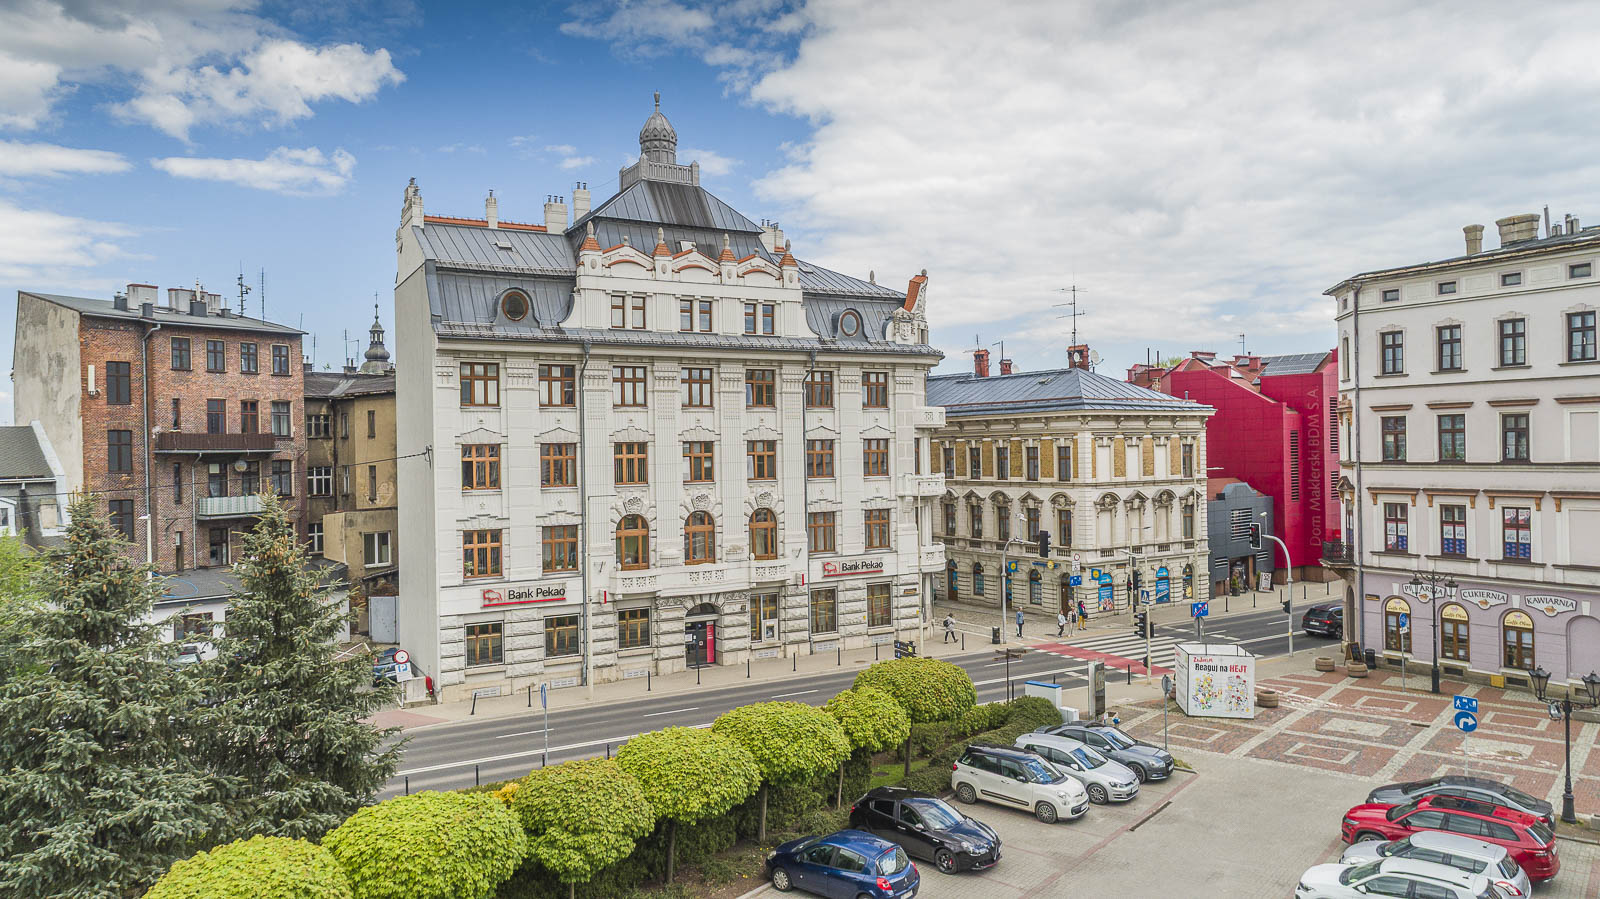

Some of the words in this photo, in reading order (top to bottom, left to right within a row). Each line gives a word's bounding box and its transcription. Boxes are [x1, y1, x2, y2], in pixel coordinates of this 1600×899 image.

[1307, 413, 1320, 447] BDM
[1308, 449, 1321, 511] Maklerski
[1309, 515, 1321, 547] Dom
[842, 562, 860, 572] Bank
[861, 560, 884, 570] Pekao
[508, 588, 534, 600] Bank
[536, 586, 566, 598] Pekao
[1404, 585, 1443, 596] PIARIA
[1462, 590, 1506, 602] CUKIERNIA
[1526, 596, 1575, 609] KAWIARNIA
[1195, 663, 1218, 673] Reaguj
[1229, 664, 1248, 673] HEJT
